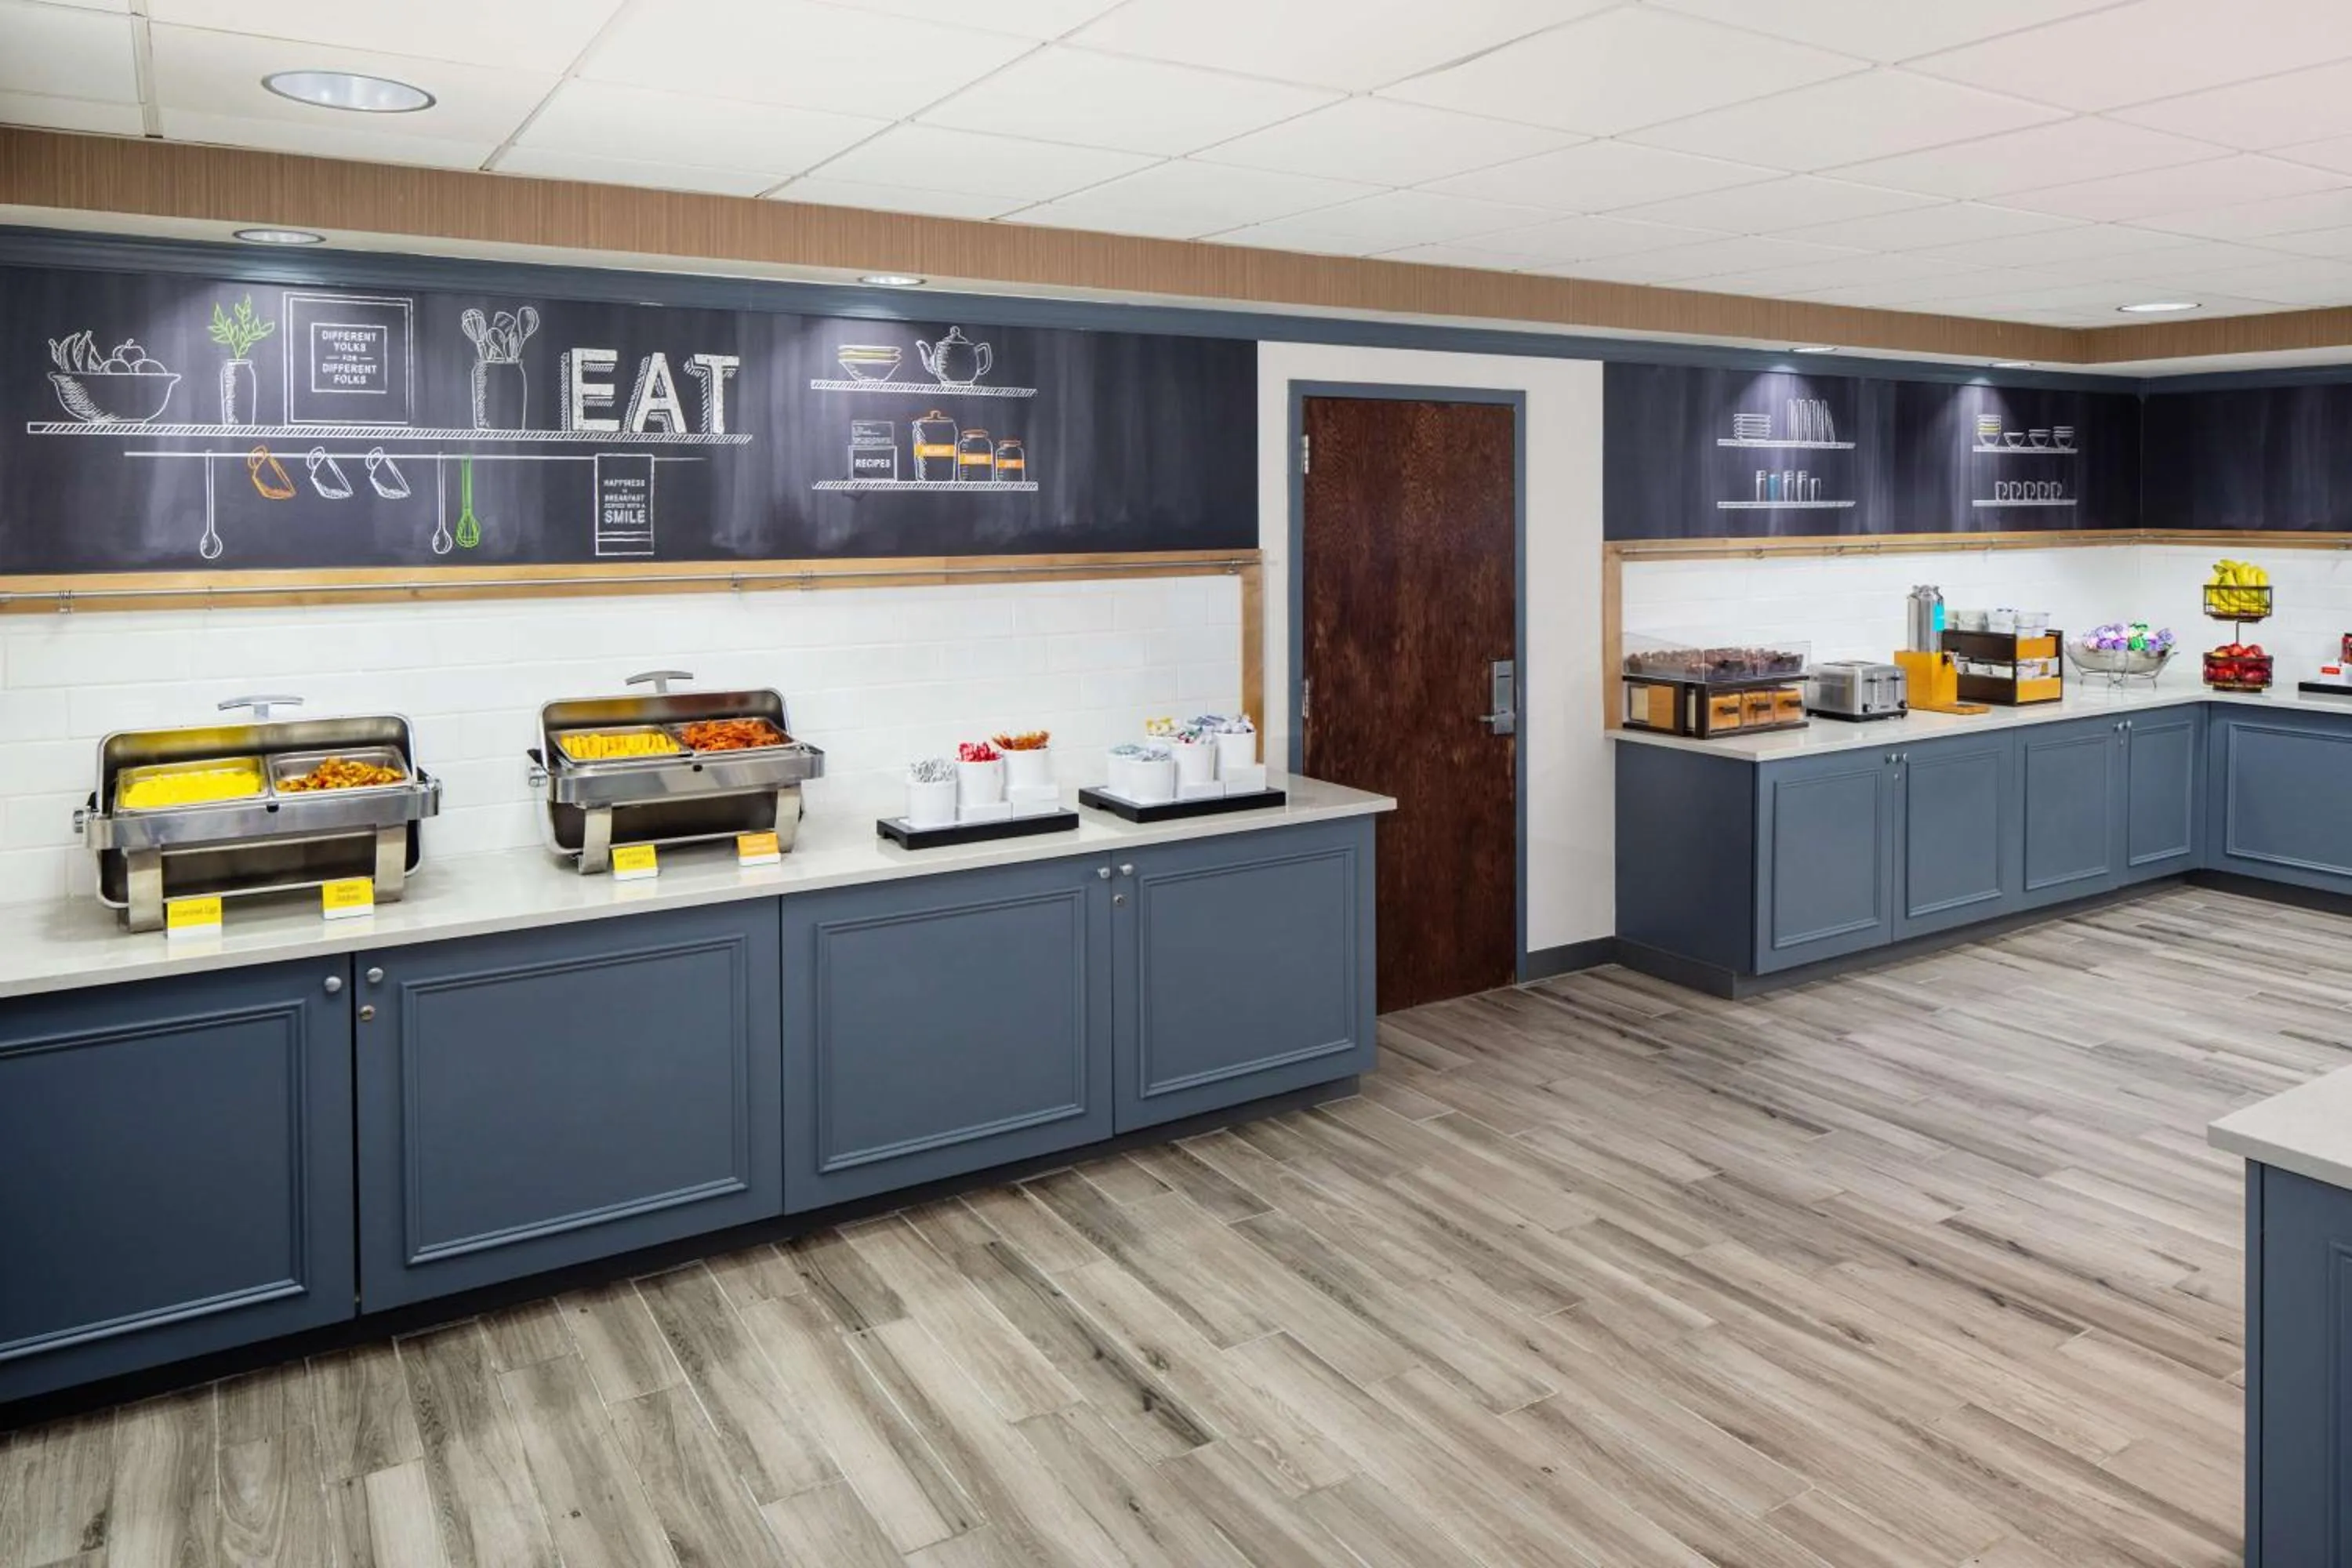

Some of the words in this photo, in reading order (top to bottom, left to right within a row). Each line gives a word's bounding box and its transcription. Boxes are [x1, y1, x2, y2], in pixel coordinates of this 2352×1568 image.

[322, 330, 376, 342] DIFFERENT
[333, 342, 366, 352] YOLKS
[322, 363, 377, 374] DIFFERENT
[333, 374, 366, 385] FOLKS
[561, 347, 740, 434] EAT
[855, 459, 891, 468] RECIPES
[604, 510, 645, 524] SMILE
